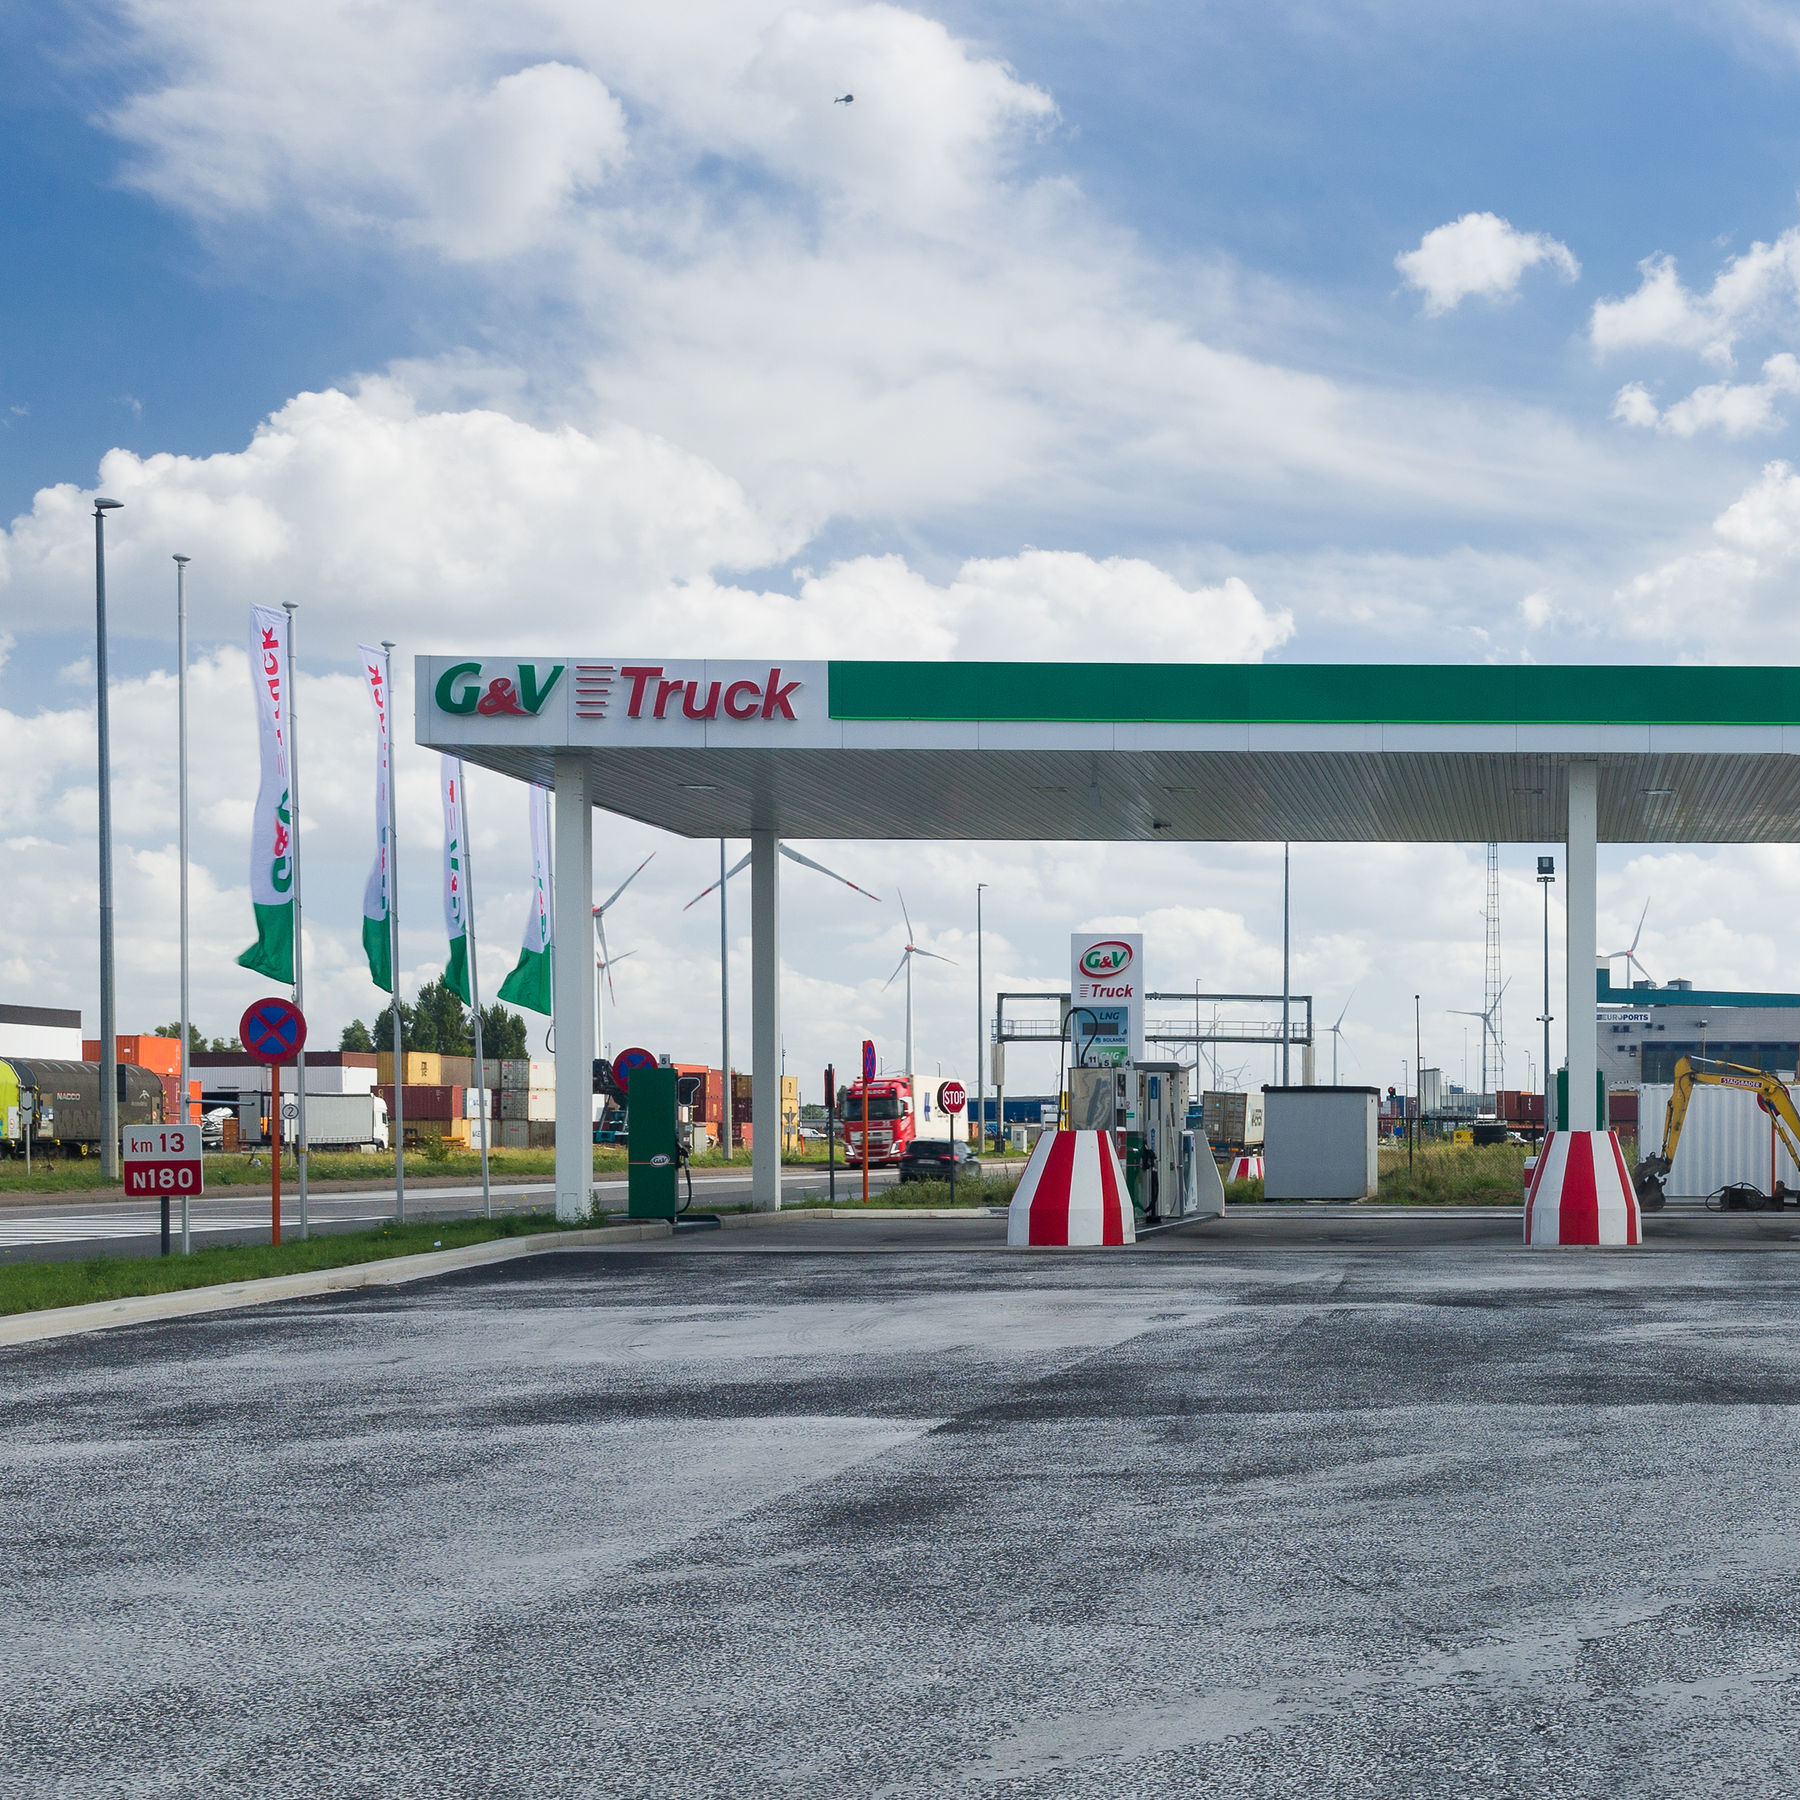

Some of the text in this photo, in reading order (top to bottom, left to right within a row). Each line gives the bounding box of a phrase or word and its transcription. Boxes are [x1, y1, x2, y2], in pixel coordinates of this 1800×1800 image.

[435, 662, 565, 715] G&V
[620, 666, 802, 719] Truck
[1085, 951, 1127, 968] G&V
[1091, 984, 1133, 997] Truck
[1100, 1012, 1119, 1020] LNG
[661, 1057, 667, 1065] 5
[944, 1092, 965, 1105] STOP
[287, 1106, 294, 1116] 2
[131, 1132, 185, 1153] km 13
[132, 1168, 193, 1189] N180
